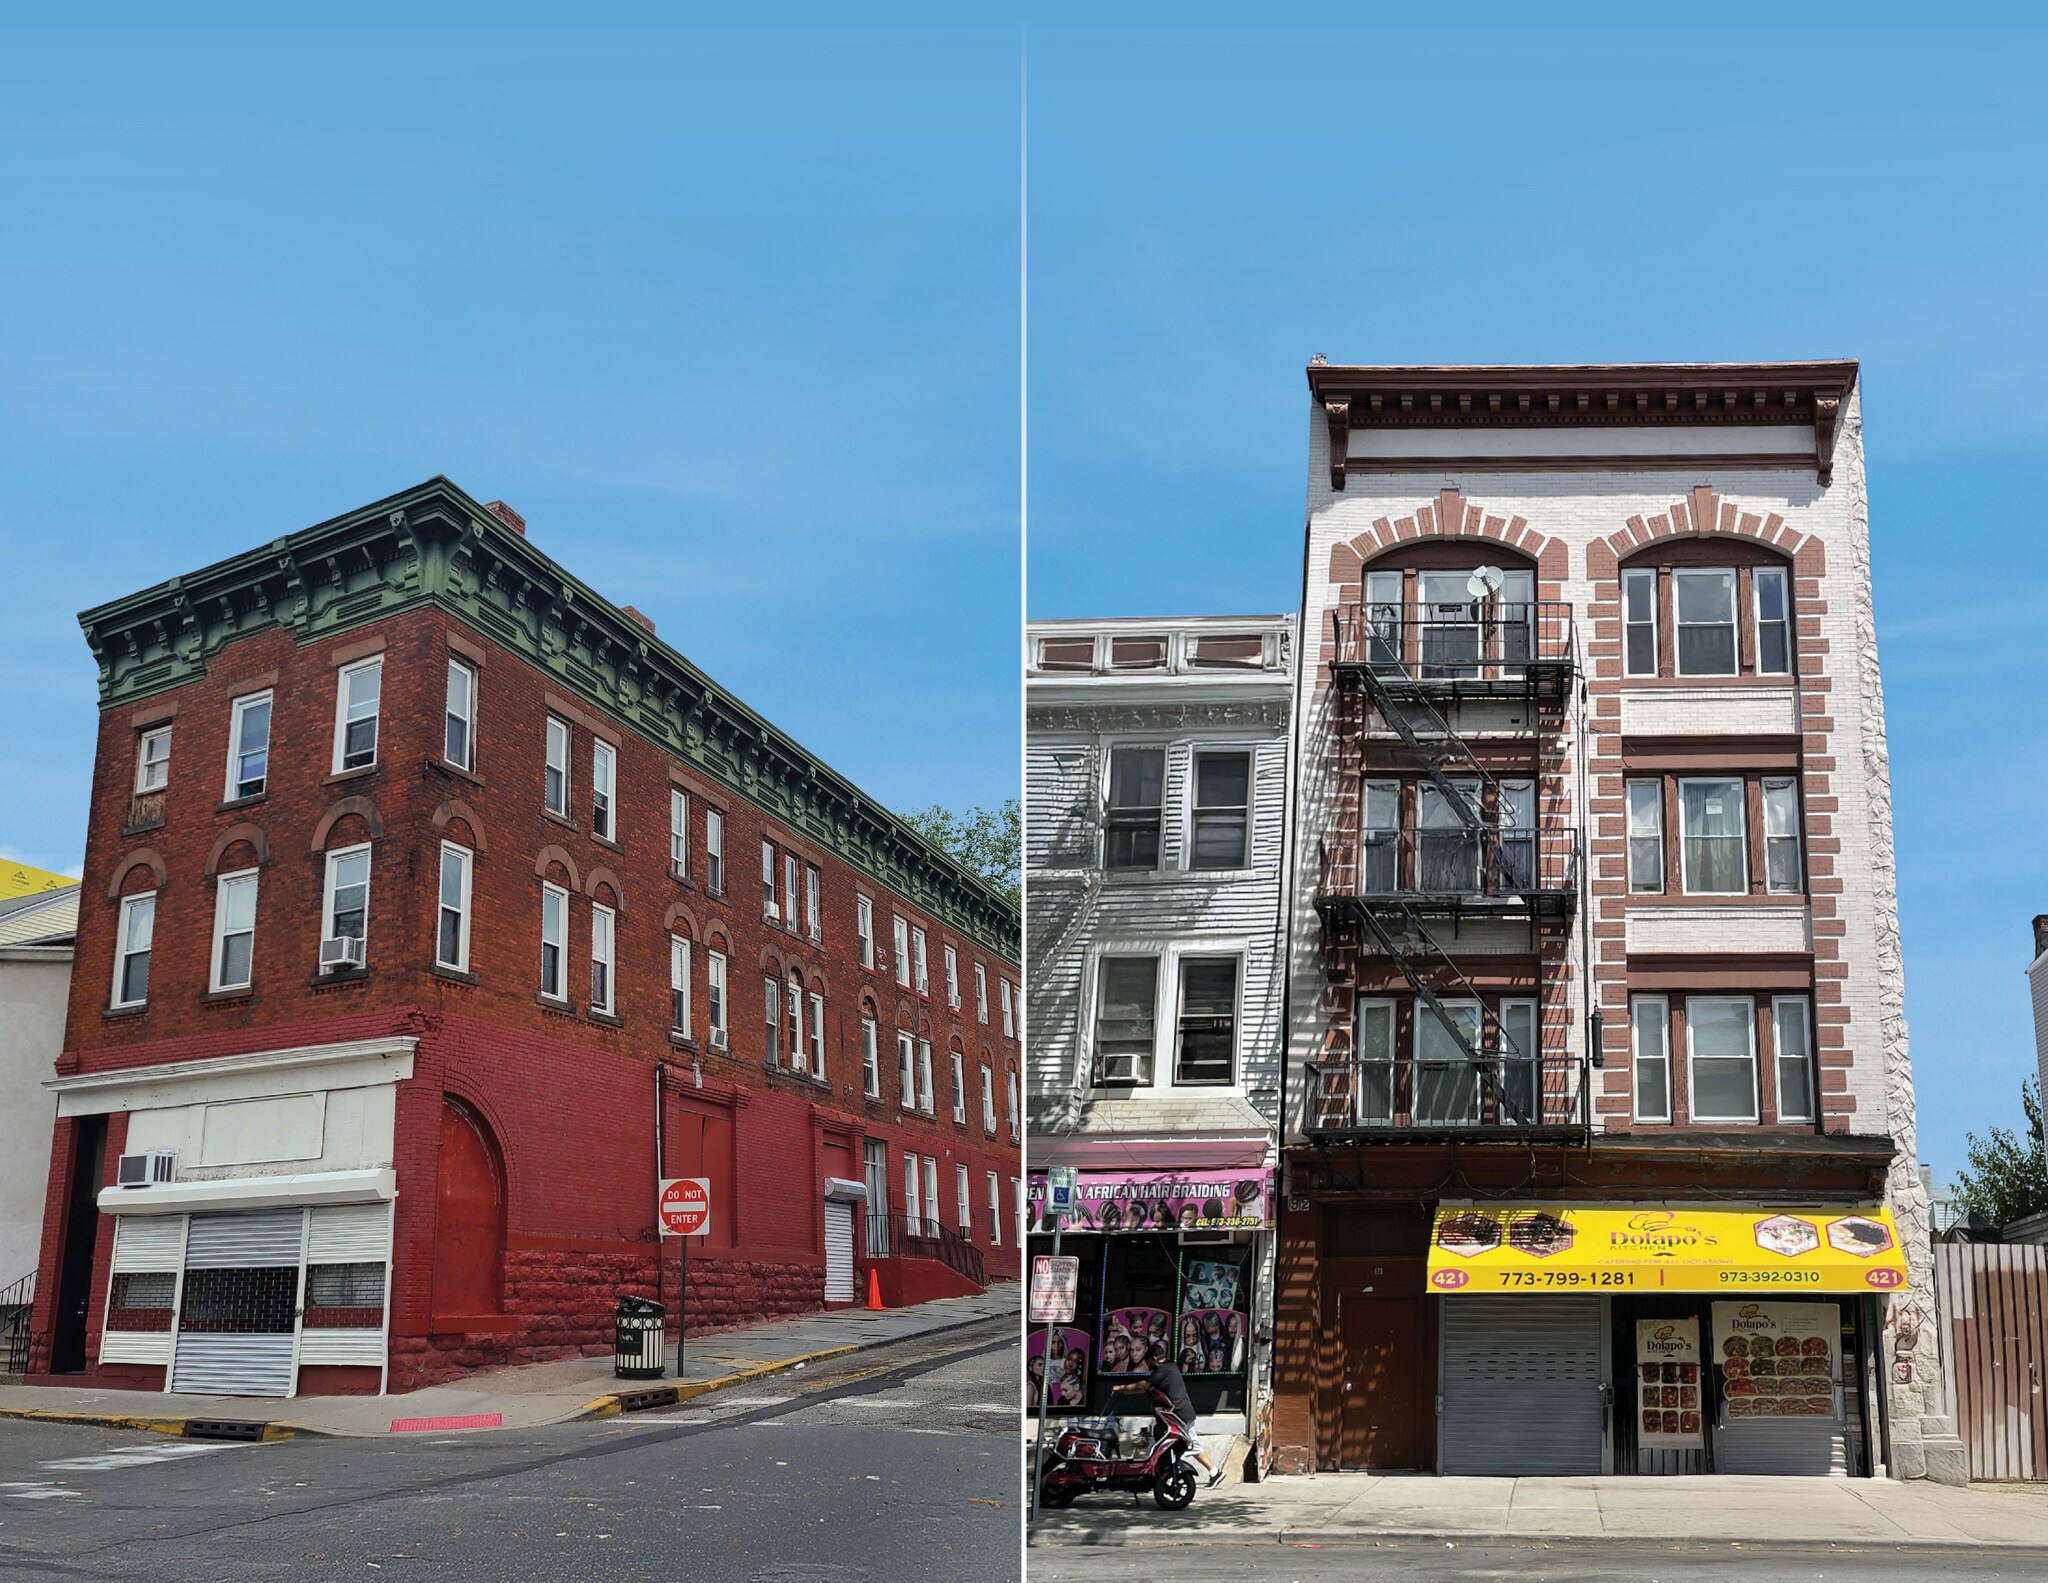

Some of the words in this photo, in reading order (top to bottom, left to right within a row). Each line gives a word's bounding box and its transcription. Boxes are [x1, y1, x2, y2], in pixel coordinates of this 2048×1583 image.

[667, 1190, 680, 1200] DO
[685, 1189, 702, 1199] NOT
[1027, 1187, 1045, 1200] EN
[1085, 1185, 1138, 1200] AFRICAN
[1139, 1184, 1170, 1199] HAIR
[1172, 1183, 1231, 1199] BRAIDING
[671, 1214, 698, 1224] ENTER
[1610, 1230, 1718, 1247] Dolapo's
[1036, 1260, 1049, 1274] NO
[1434, 1272, 1465, 1285] 421
[1499, 1272, 1634, 1286] 773-799-1281
[1719, 1271, 1820, 1283] 973-392-0310
[1867, 1271, 1899, 1284] 421
[1732, 1318, 1777, 1330] Dolapo's
[1647, 1339, 1692, 1352] Dolapo's
